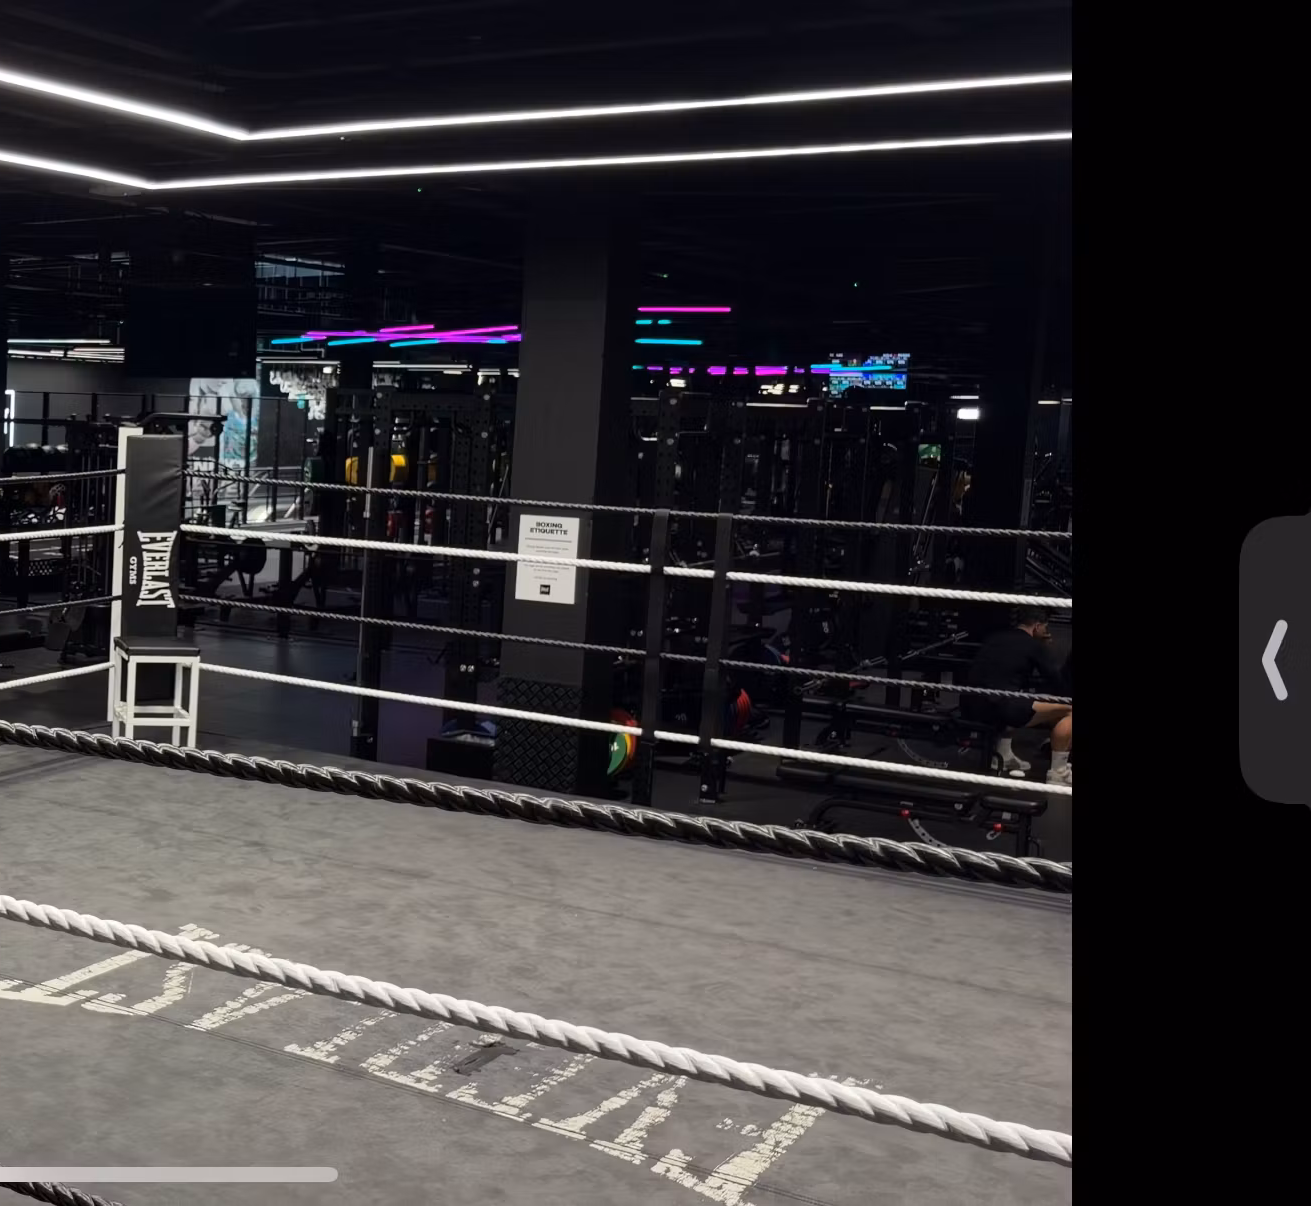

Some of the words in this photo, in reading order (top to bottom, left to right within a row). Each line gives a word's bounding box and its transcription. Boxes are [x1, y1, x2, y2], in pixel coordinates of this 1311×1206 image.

[529, 527, 568, 535] ETIQUETTE
[535, 521, 562, 529] BOXING
[129, 556, 137, 585] GYMS
[136, 530, 177, 608] EVERLAST
